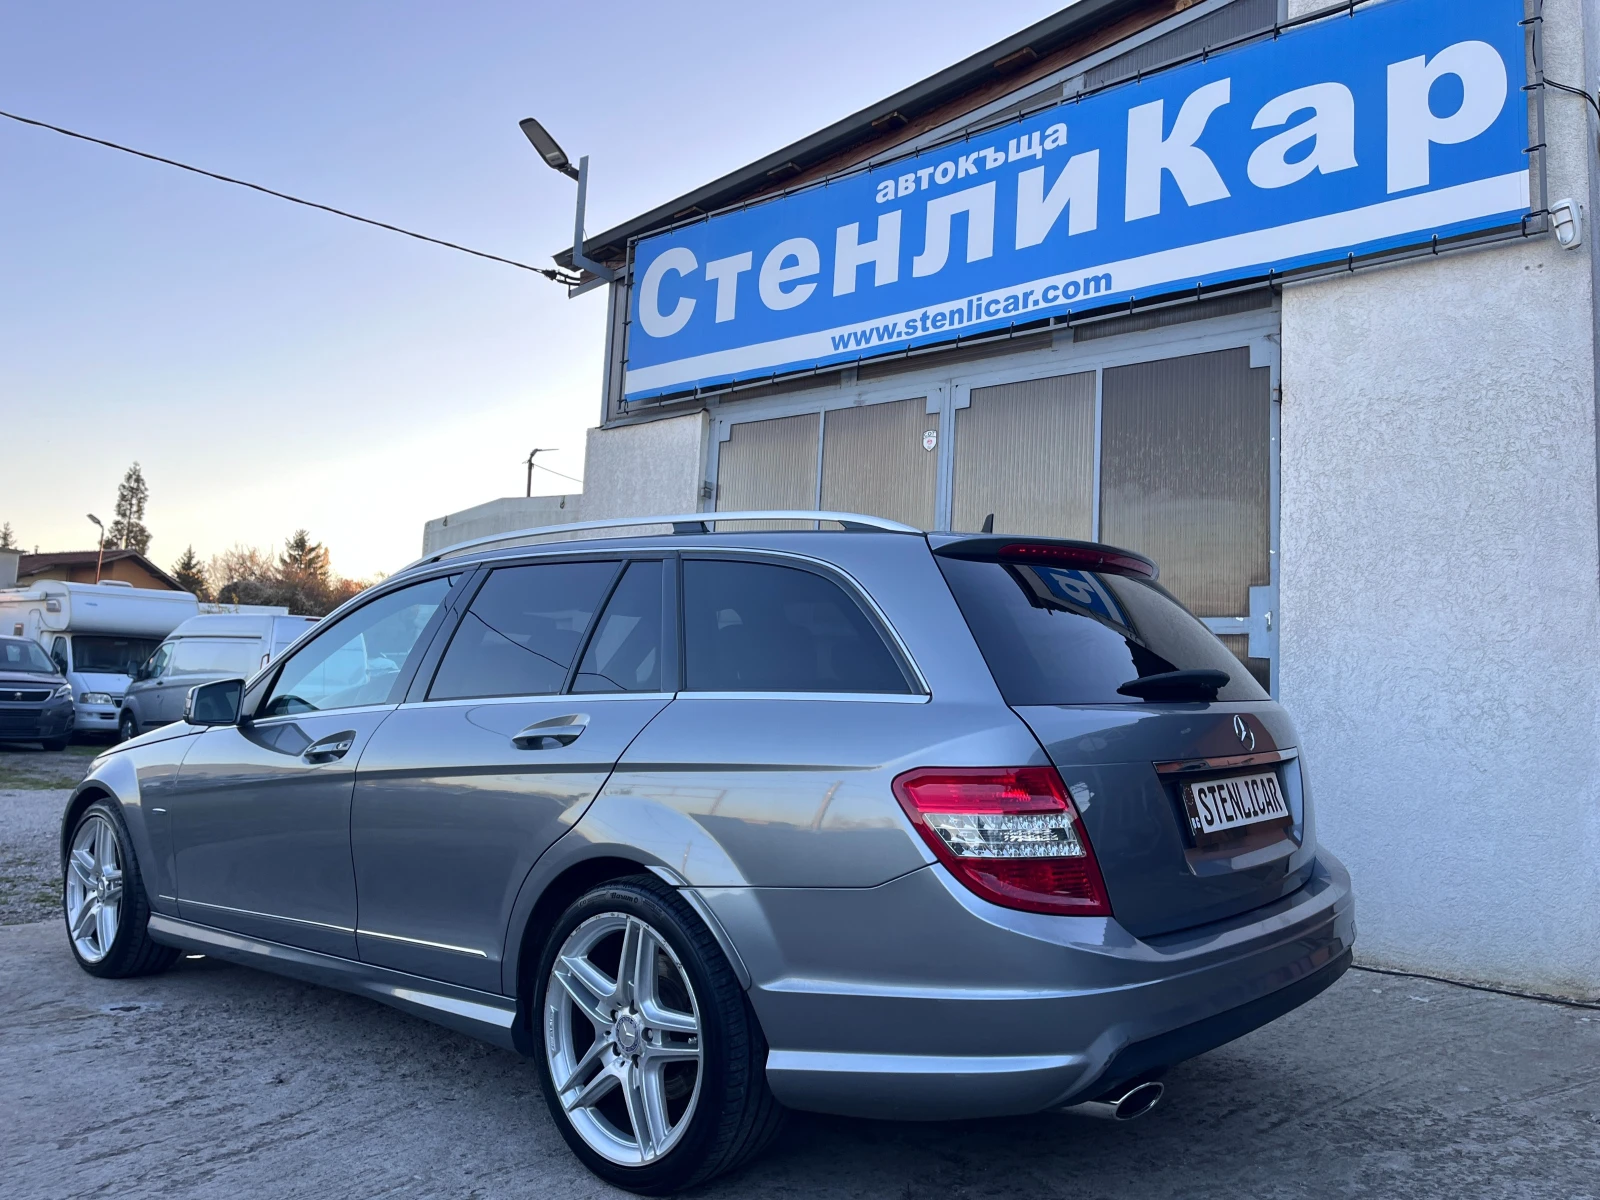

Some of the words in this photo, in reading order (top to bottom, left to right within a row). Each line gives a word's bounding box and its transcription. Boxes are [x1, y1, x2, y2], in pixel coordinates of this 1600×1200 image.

[638, 40, 1508, 338] СтенлиКар
[876, 123, 1067, 204] автокъща
[830, 272, 1112, 352] www.stenlicar.com
[1197, 777, 1283, 827] STENLICAR
